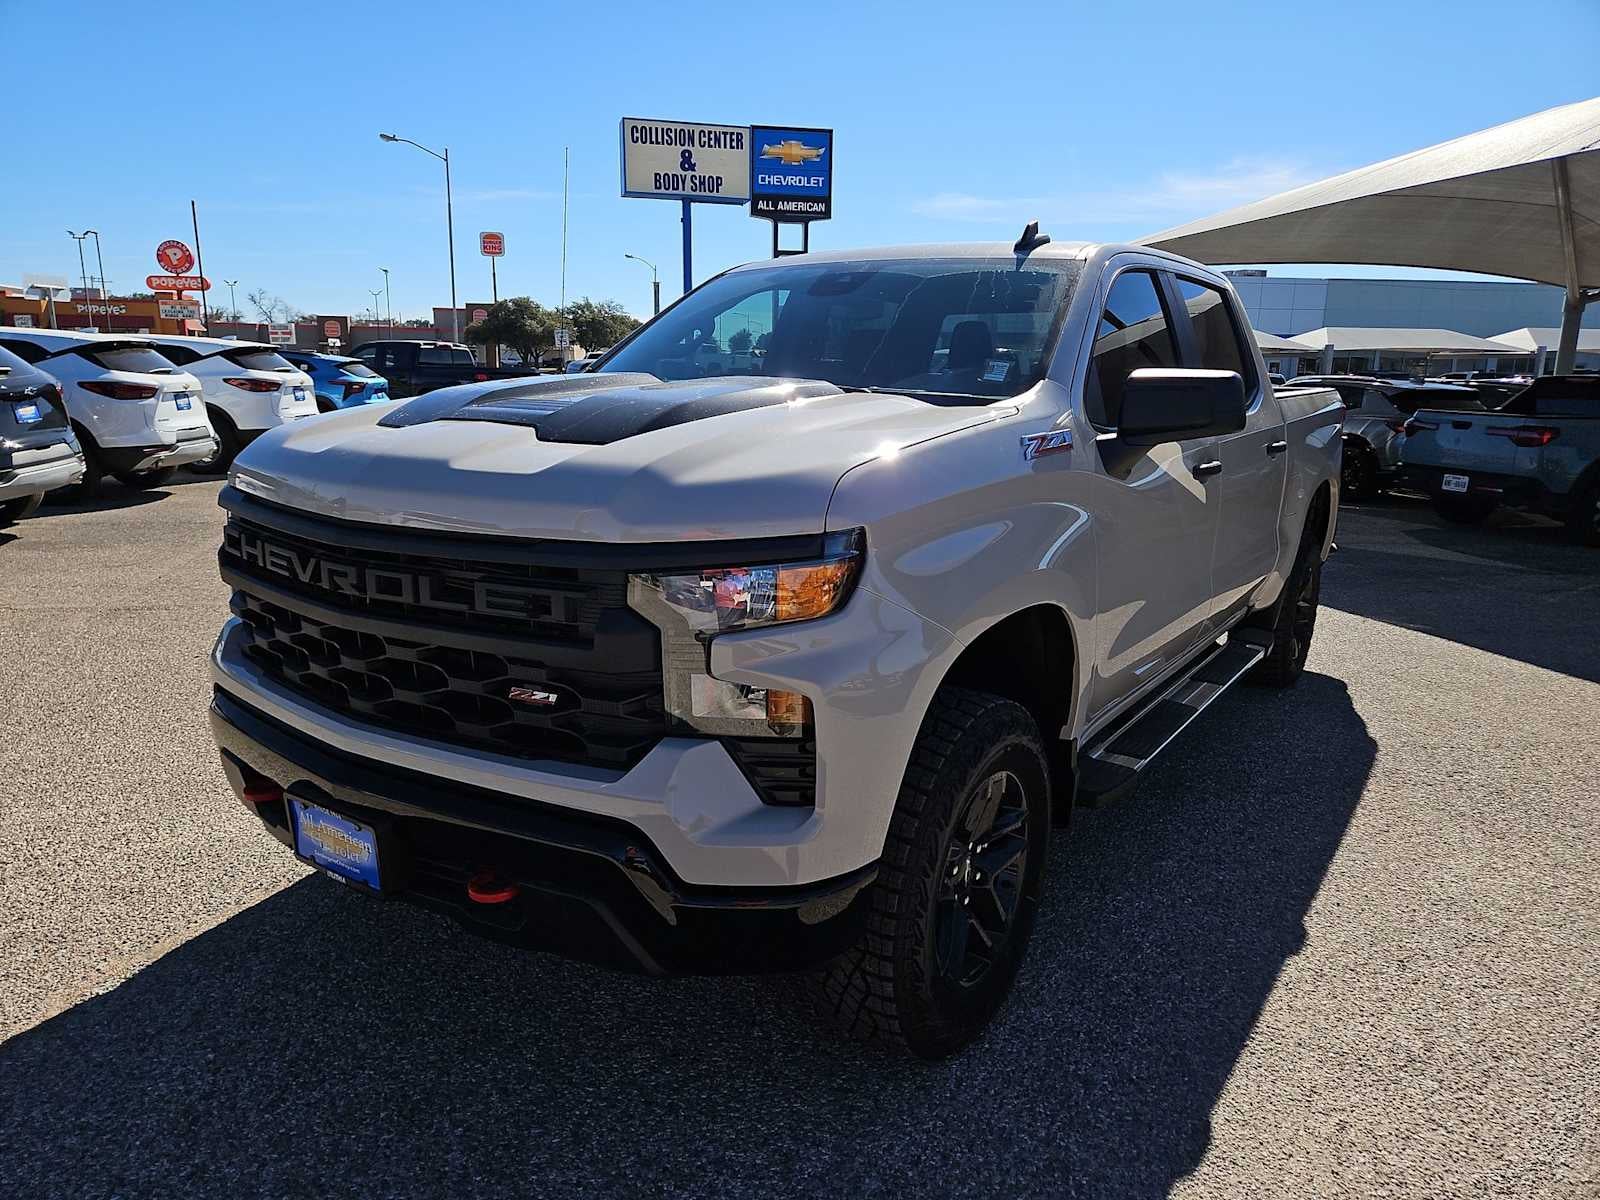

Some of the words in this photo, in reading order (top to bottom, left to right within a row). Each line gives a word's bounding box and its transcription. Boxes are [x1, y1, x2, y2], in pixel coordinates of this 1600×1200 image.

[630, 125, 695, 148] COLLISION
[698, 129, 744, 150] CENTER
[680, 149, 697, 172] &
[654, 173, 687, 192] BODY
[690, 175, 723, 194] SHOP
[758, 174, 825, 187] CHEVROLET
[757, 200, 775, 210] ALL
[777, 201, 826, 213] AMERICAN
[223, 527, 592, 625] CHEVROLET
[509, 687, 558, 705] Z71
[299, 811, 314, 830] All
[315, 820, 374, 854] American
